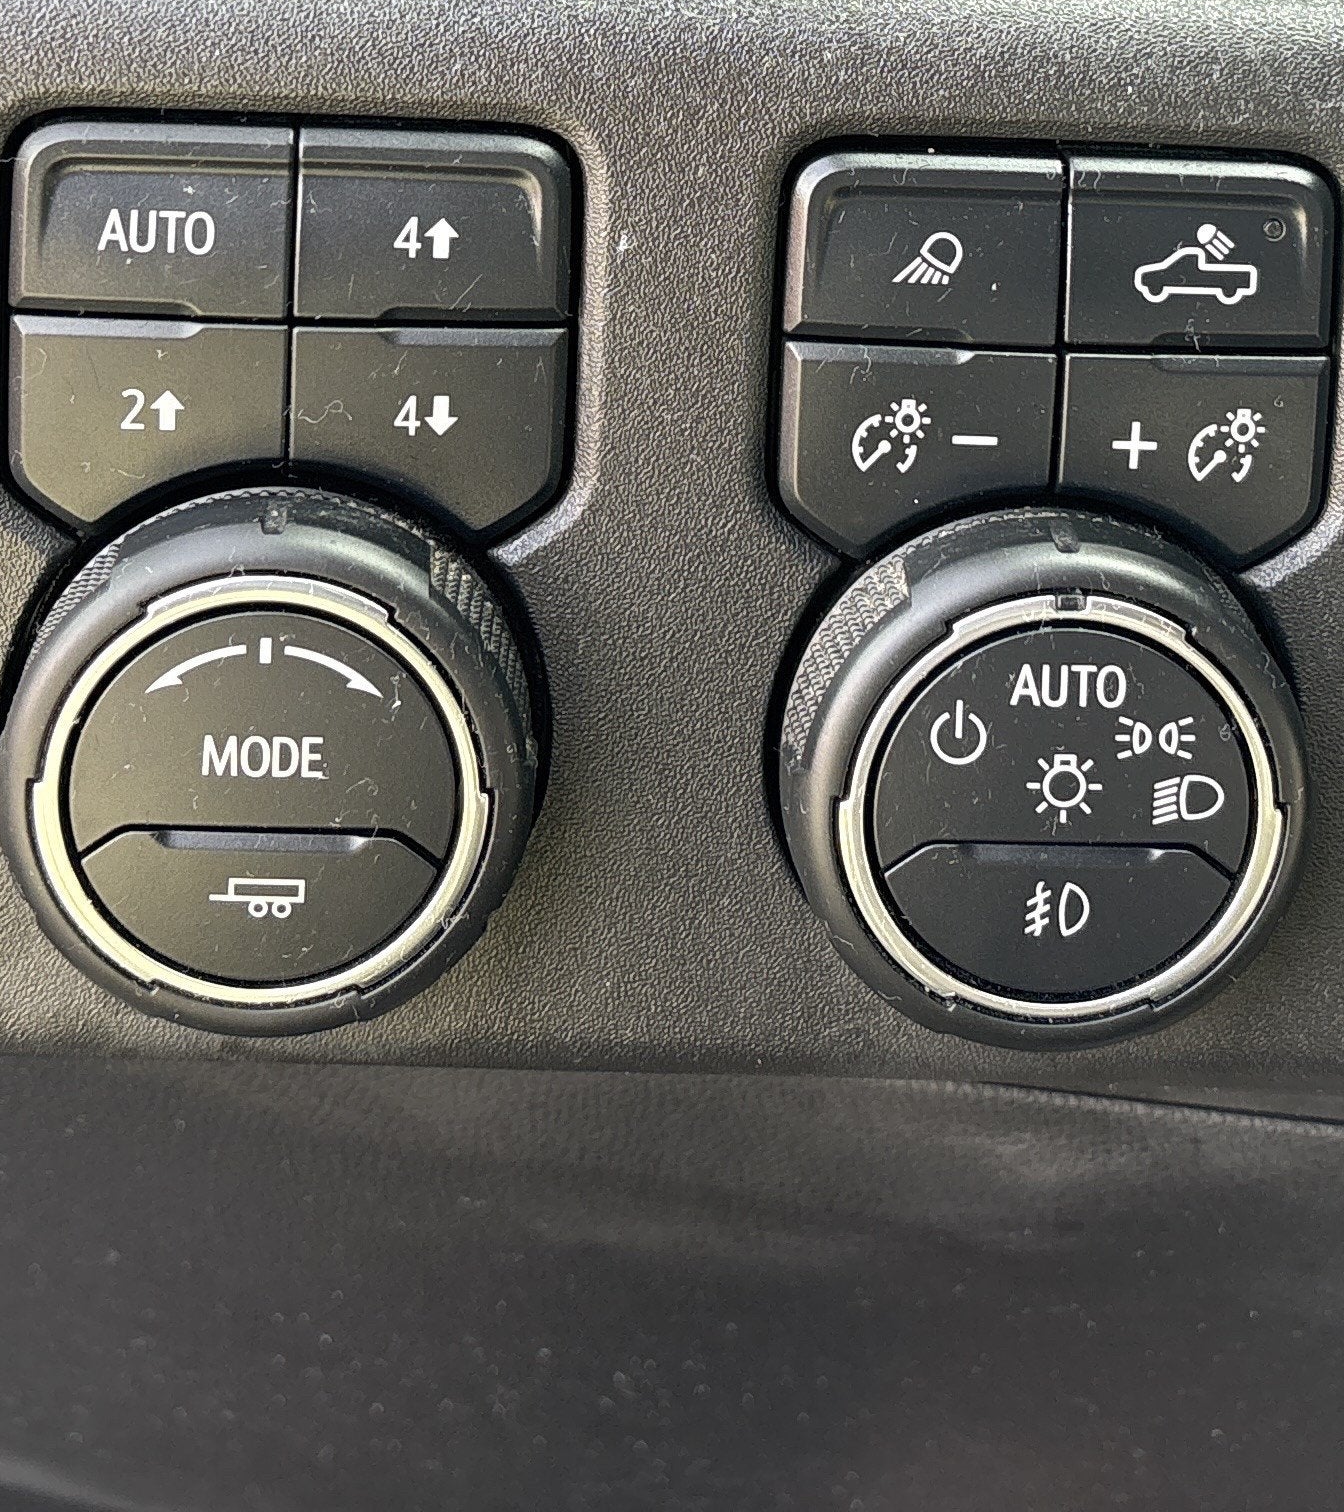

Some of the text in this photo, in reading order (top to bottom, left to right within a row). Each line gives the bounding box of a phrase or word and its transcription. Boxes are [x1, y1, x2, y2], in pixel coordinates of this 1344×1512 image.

[97, 209, 215, 255] AUTO
[393, 217, 421, 258] 4
[120, 389, 146, 430] 2
[393, 395, 421, 436] 4
[1010, 665, 1127, 709] AUTO
[201, 735, 323, 779] MODE
